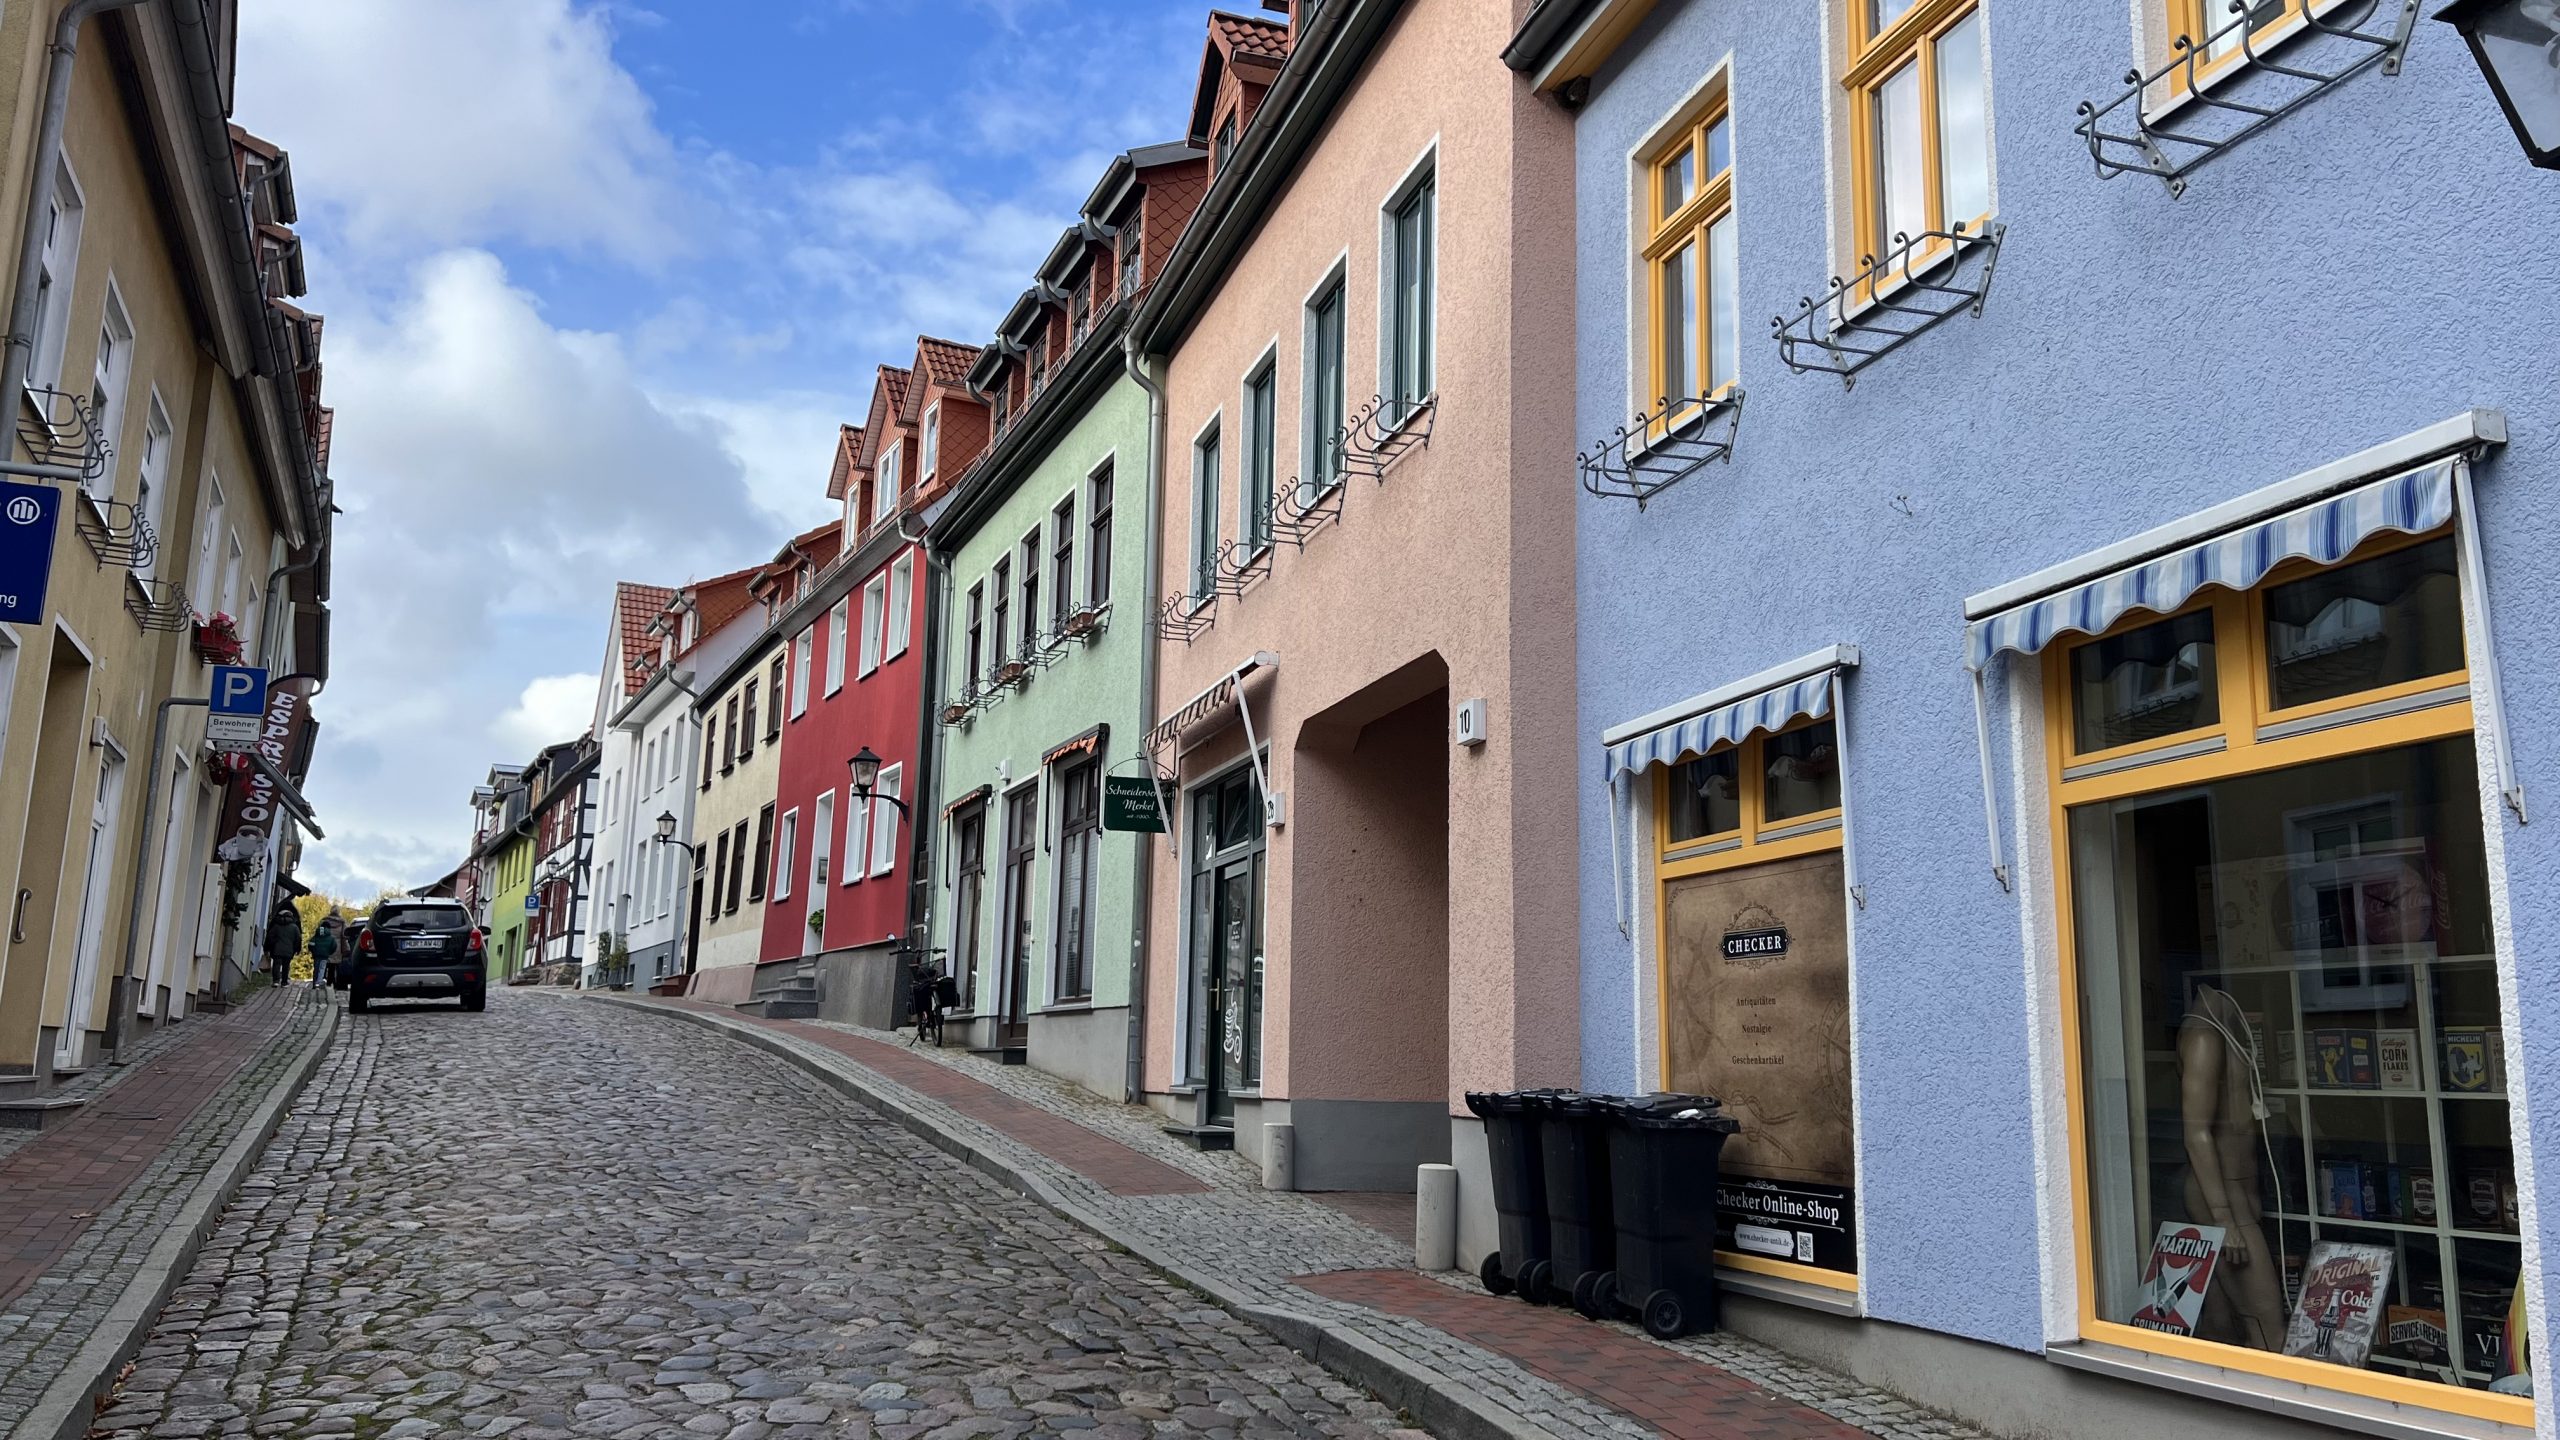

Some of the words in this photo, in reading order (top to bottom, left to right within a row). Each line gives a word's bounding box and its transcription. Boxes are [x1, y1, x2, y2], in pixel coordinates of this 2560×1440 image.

[223, 672, 254, 707] P
[213, 718, 256, 728] Bewohner
[1460, 708, 1470, 734] 10
[1122, 799, 1155, 811] Merkel
[1728, 935, 1782, 953] CHECKER
[1742, 1024, 1772, 1035] Nostalgie
[2447, 1035, 2481, 1043] MICHELIN
[1732, 1054, 1784, 1065] Geschenkartikel
[2382, 1048, 2408, 1061] CORN
[2383, 1062, 2409, 1071] FLAKES
[1716, 1188, 1760, 1210] Checker
[1763, 1195, 1839, 1225] Online-Shop
[2158, 1236, 2212, 1259] MARTINI
[2307, 1256, 2383, 1288] ORIGINAL
[2341, 1289, 2375, 1308] Coke
[2391, 1322, 2419, 1341] SERVICE
